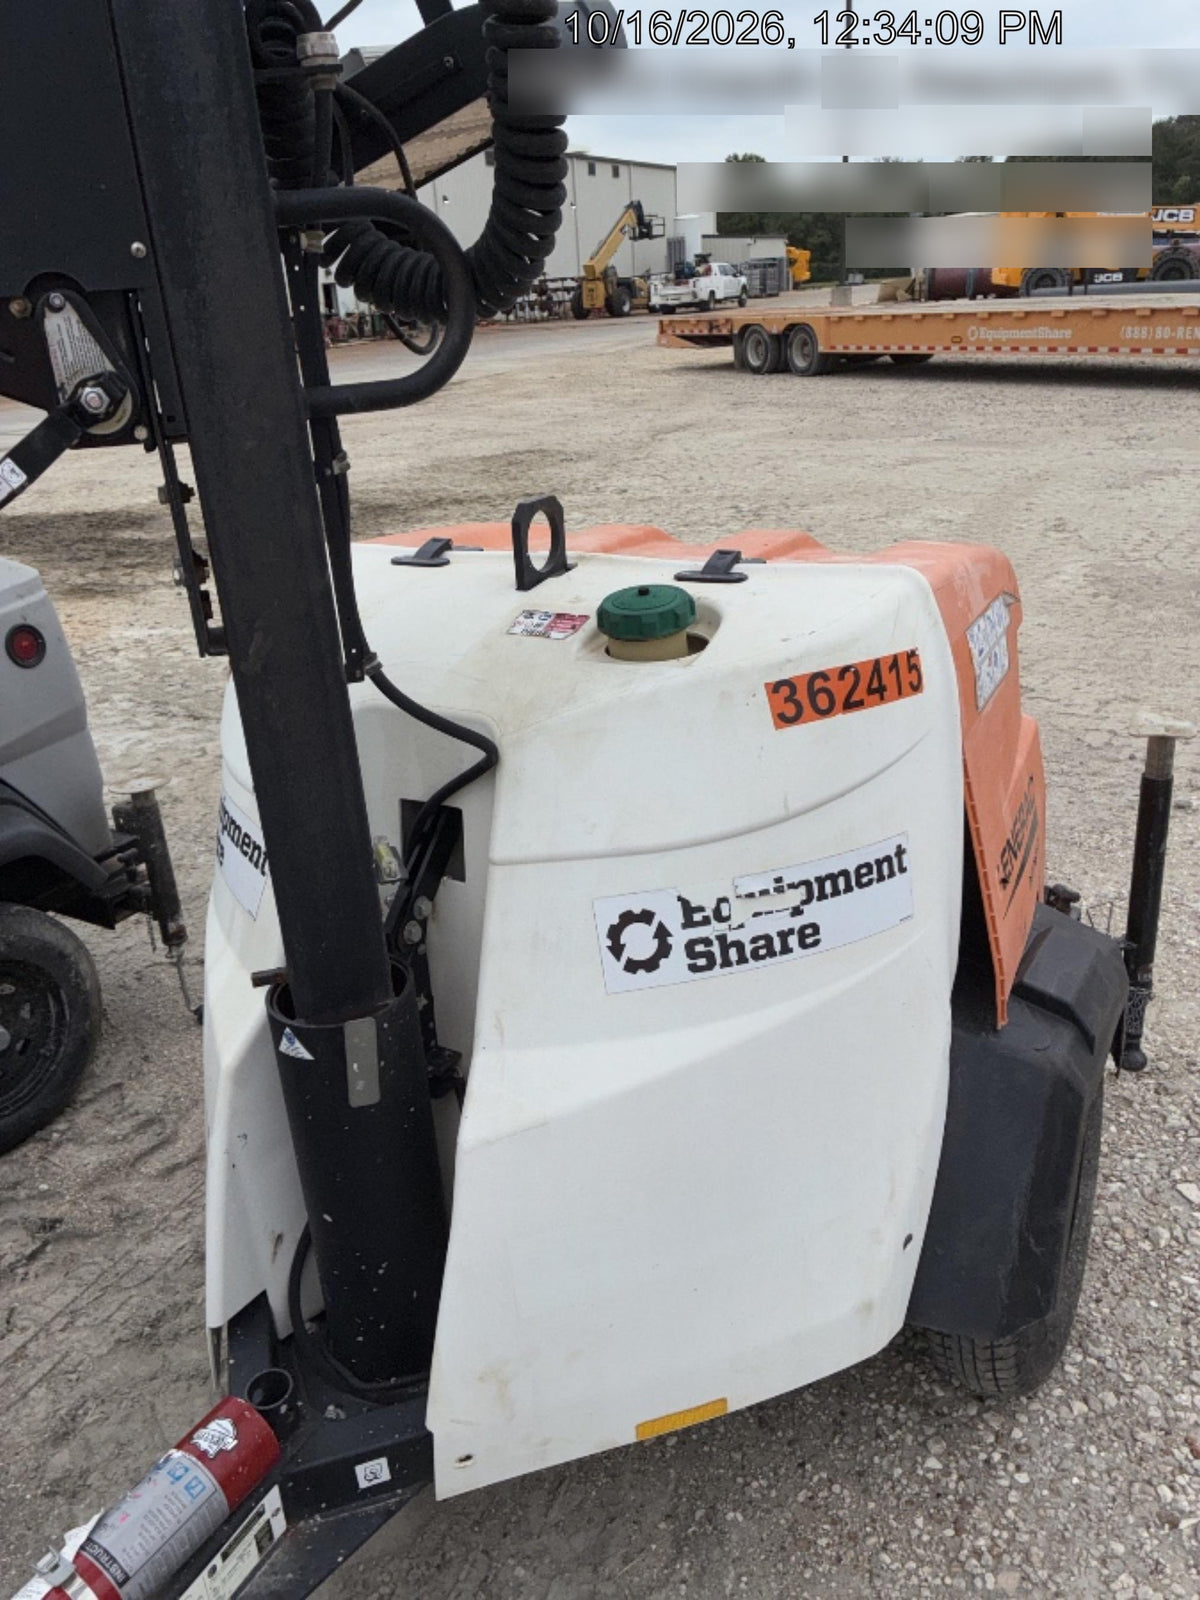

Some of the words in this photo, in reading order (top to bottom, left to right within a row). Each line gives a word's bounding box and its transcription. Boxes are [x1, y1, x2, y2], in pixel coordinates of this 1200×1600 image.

[1152, 208, 1195, 222] JCB
[1093, 271, 1123, 283] JCB
[979, 326, 1073, 340] EquipmentShare
[771, 647, 923, 725] 362415
[684, 921, 822, 974] Share
